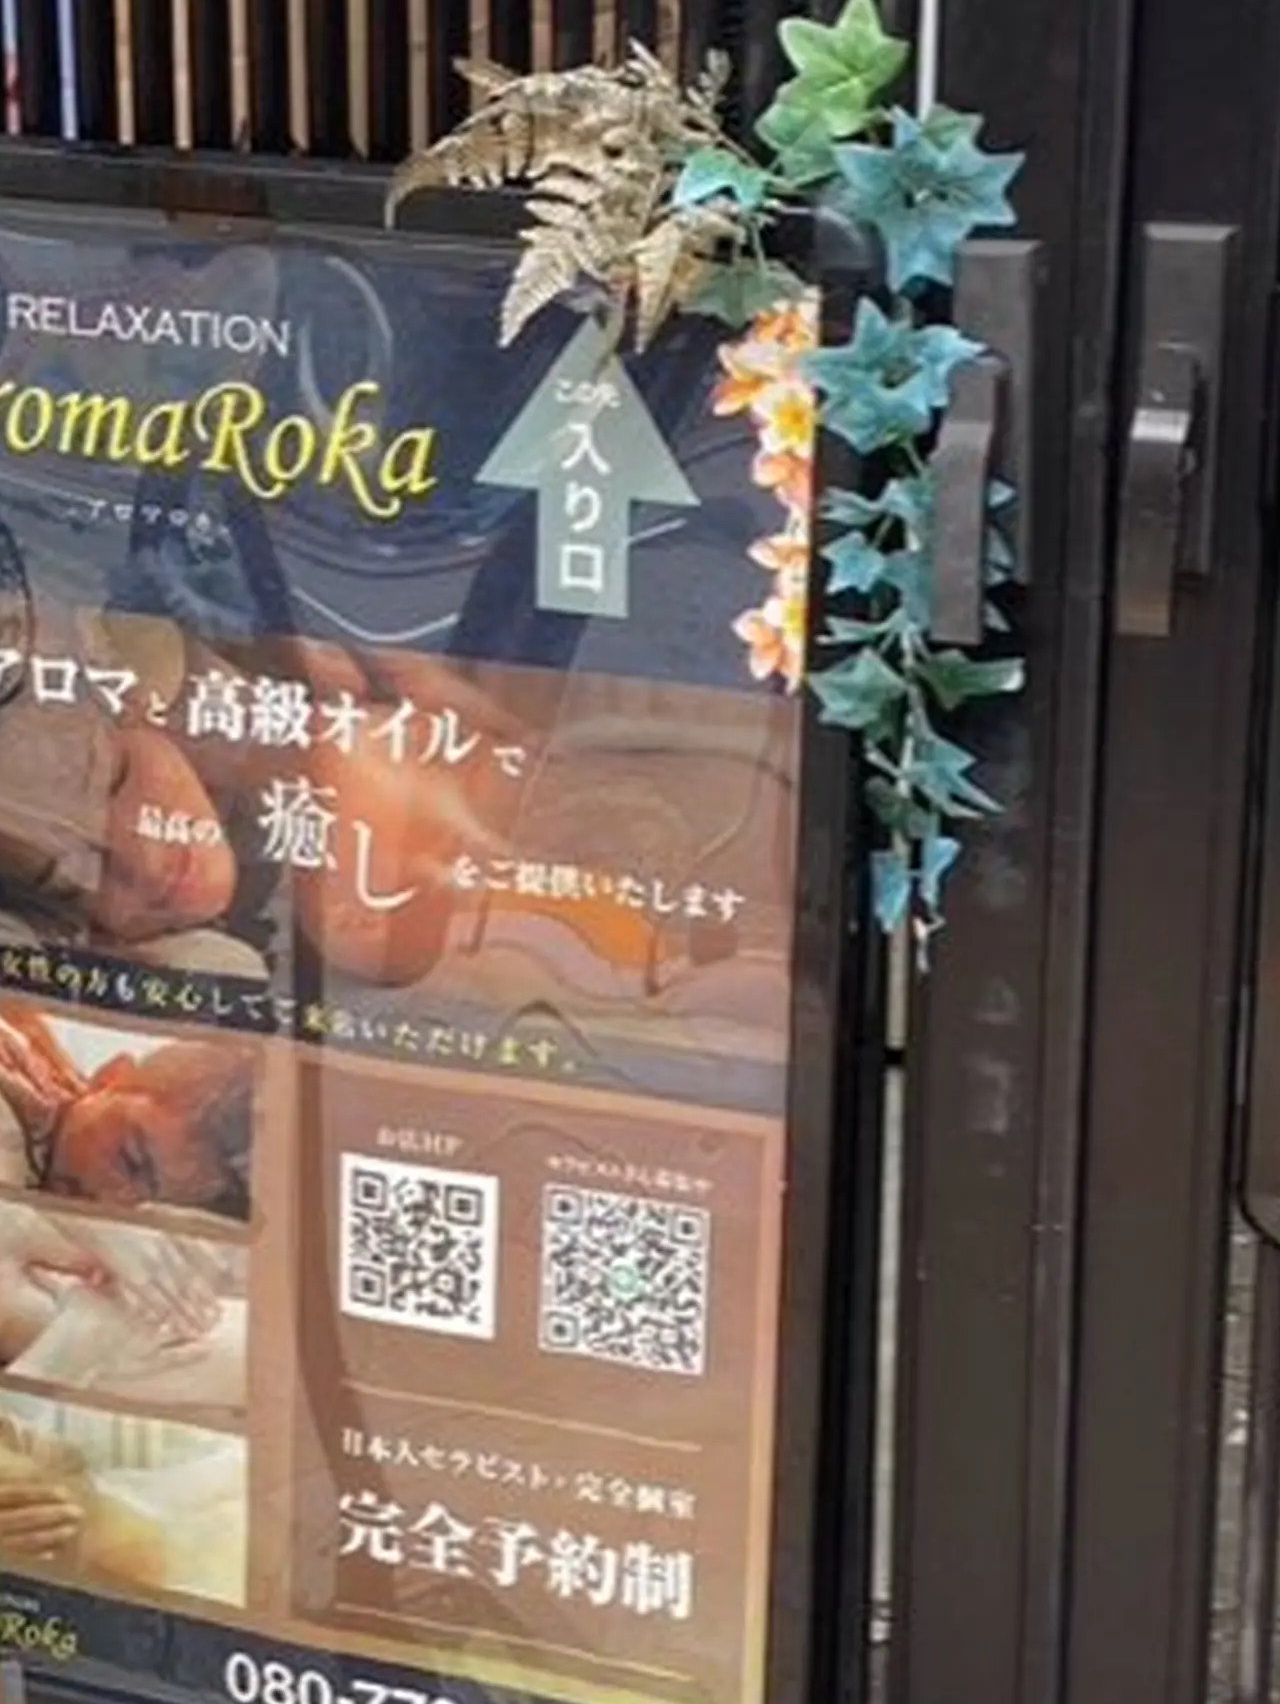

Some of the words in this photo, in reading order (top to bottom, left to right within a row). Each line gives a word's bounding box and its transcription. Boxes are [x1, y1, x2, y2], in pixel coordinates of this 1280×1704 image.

[7, 293, 290, 357] RELAXATION
[559, 422, 611, 593] 入り口
[339, 1490, 695, 1620] 完全予約制
